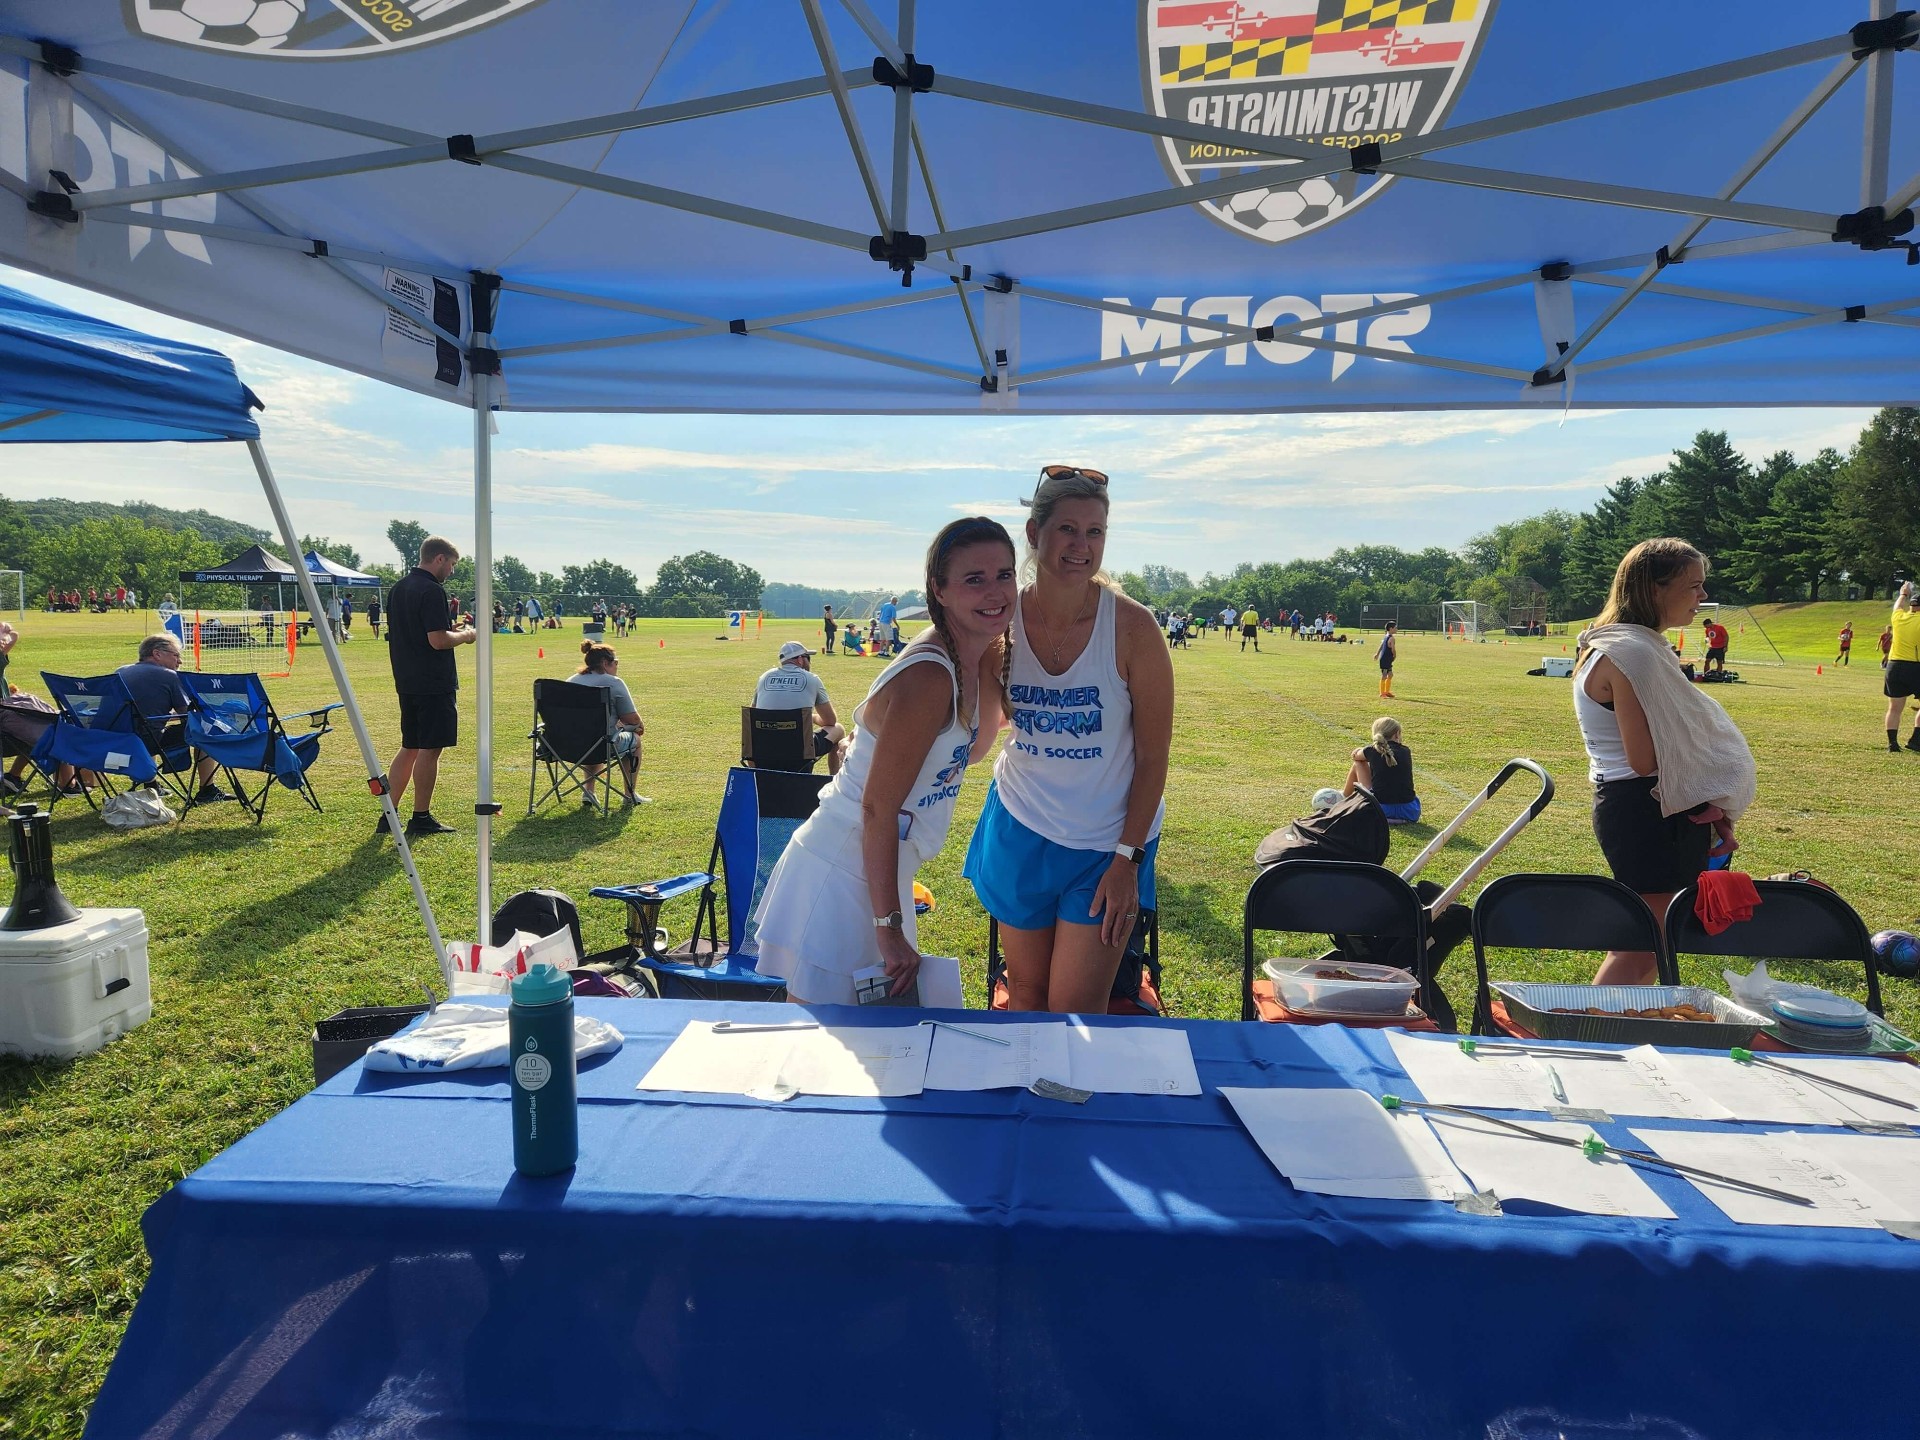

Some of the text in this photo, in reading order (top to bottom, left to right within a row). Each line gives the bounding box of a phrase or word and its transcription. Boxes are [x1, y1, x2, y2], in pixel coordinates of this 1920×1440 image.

[394, 276, 420, 294] WARNING
[729, 612, 740, 627] 2
[769, 677, 800, 685] O'NEILL
[1010, 685, 1104, 709] SUMMER
[1011, 707, 1102, 739] STORM
[1045, 747, 1103, 760] SOCCER
[524, 1058, 537, 1068] 10
[529, 1094, 537, 1140] ThermoFlask
